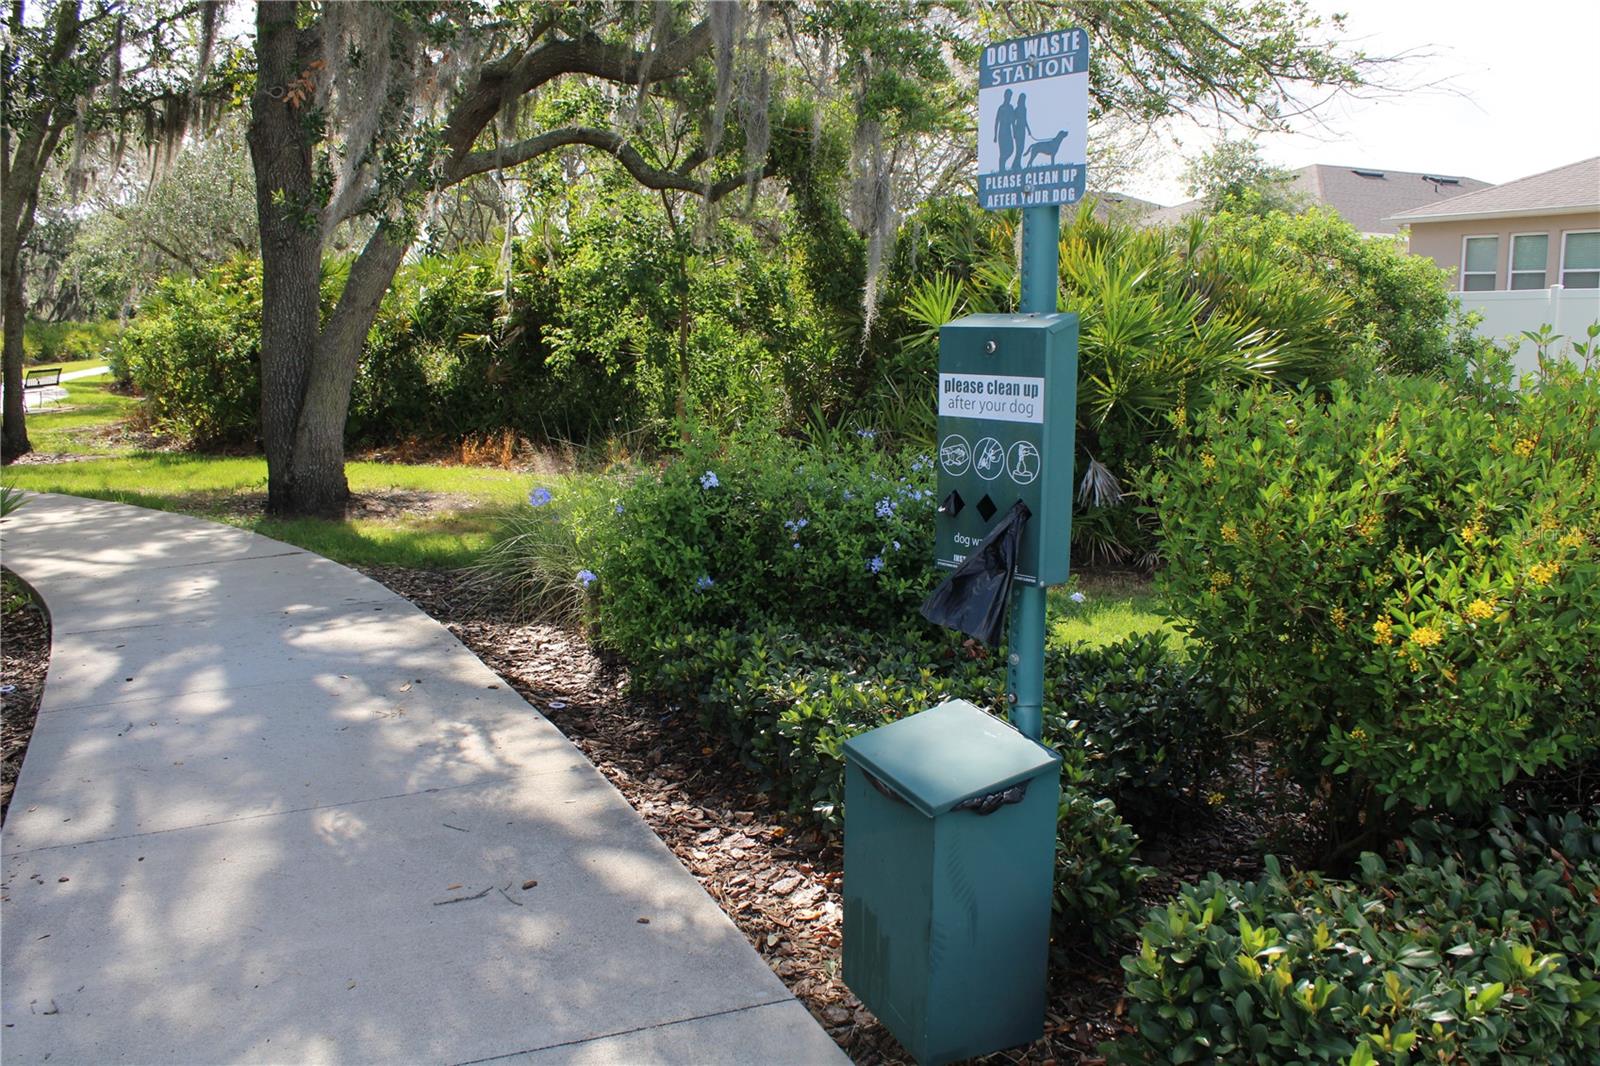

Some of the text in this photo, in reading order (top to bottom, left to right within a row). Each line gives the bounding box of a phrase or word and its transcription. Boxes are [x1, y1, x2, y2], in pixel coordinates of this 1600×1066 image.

[986, 30, 1081, 67] DOG WASTE
[991, 56, 1074, 86] STATION
[985, 168, 1078, 190] PLEASE CLEAN UP
[986, 187, 1076, 208] AFTER YOUR DOG
[944, 377, 1039, 399] please clean up
[948, 395, 1034, 418] after your dog
[953, 532, 970, 548] dog
